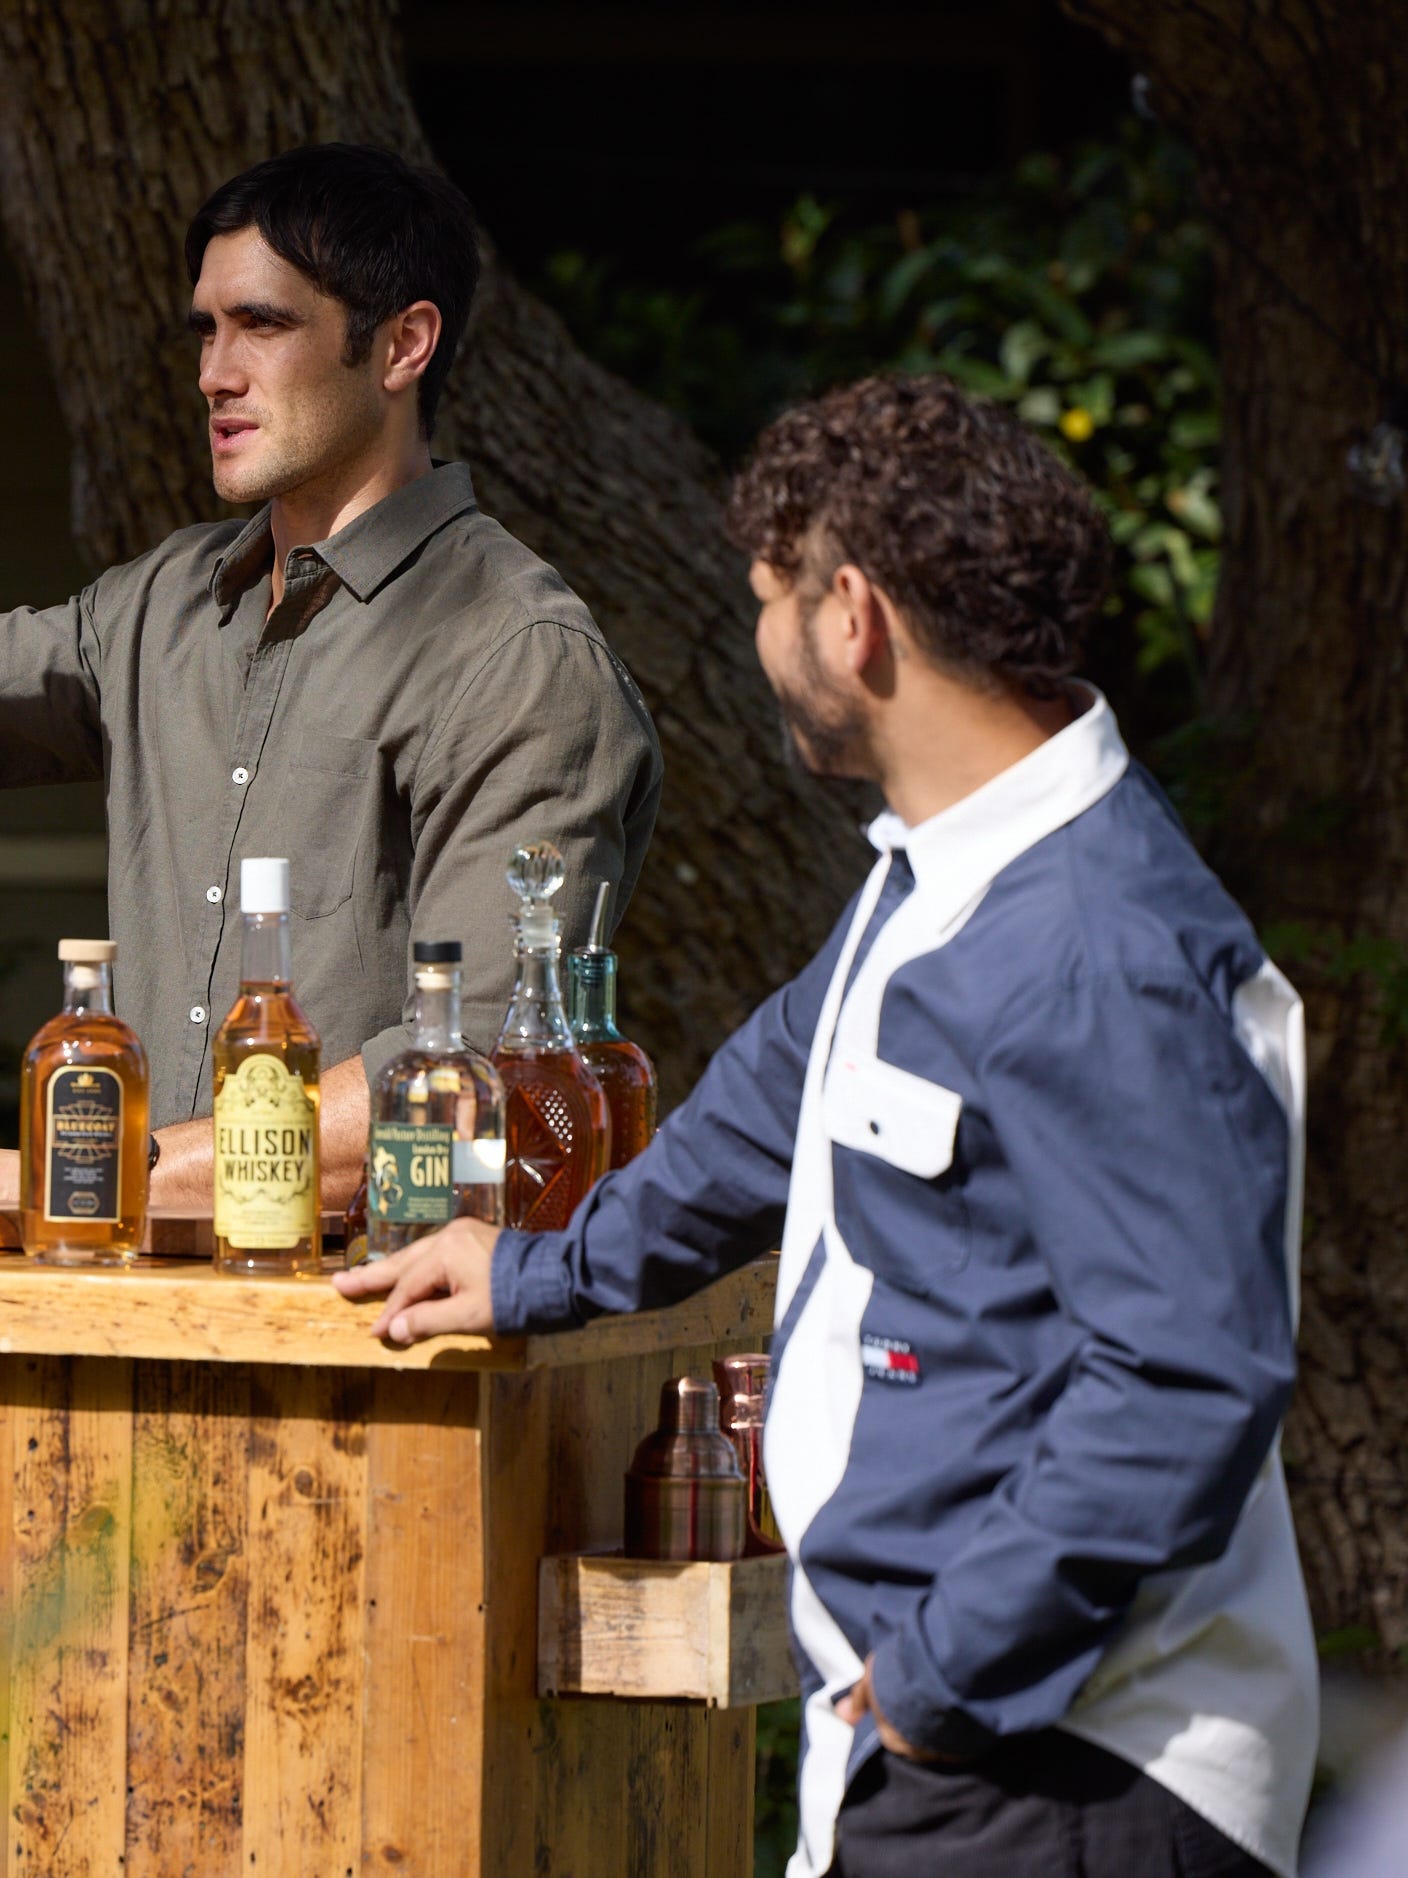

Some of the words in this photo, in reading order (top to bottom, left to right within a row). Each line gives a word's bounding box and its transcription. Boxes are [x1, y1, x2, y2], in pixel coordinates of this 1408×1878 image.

[220, 1128, 312, 1156] ELLISON
[224, 1160, 305, 1183] WHISKEY
[410, 1155, 450, 1188] GIN
